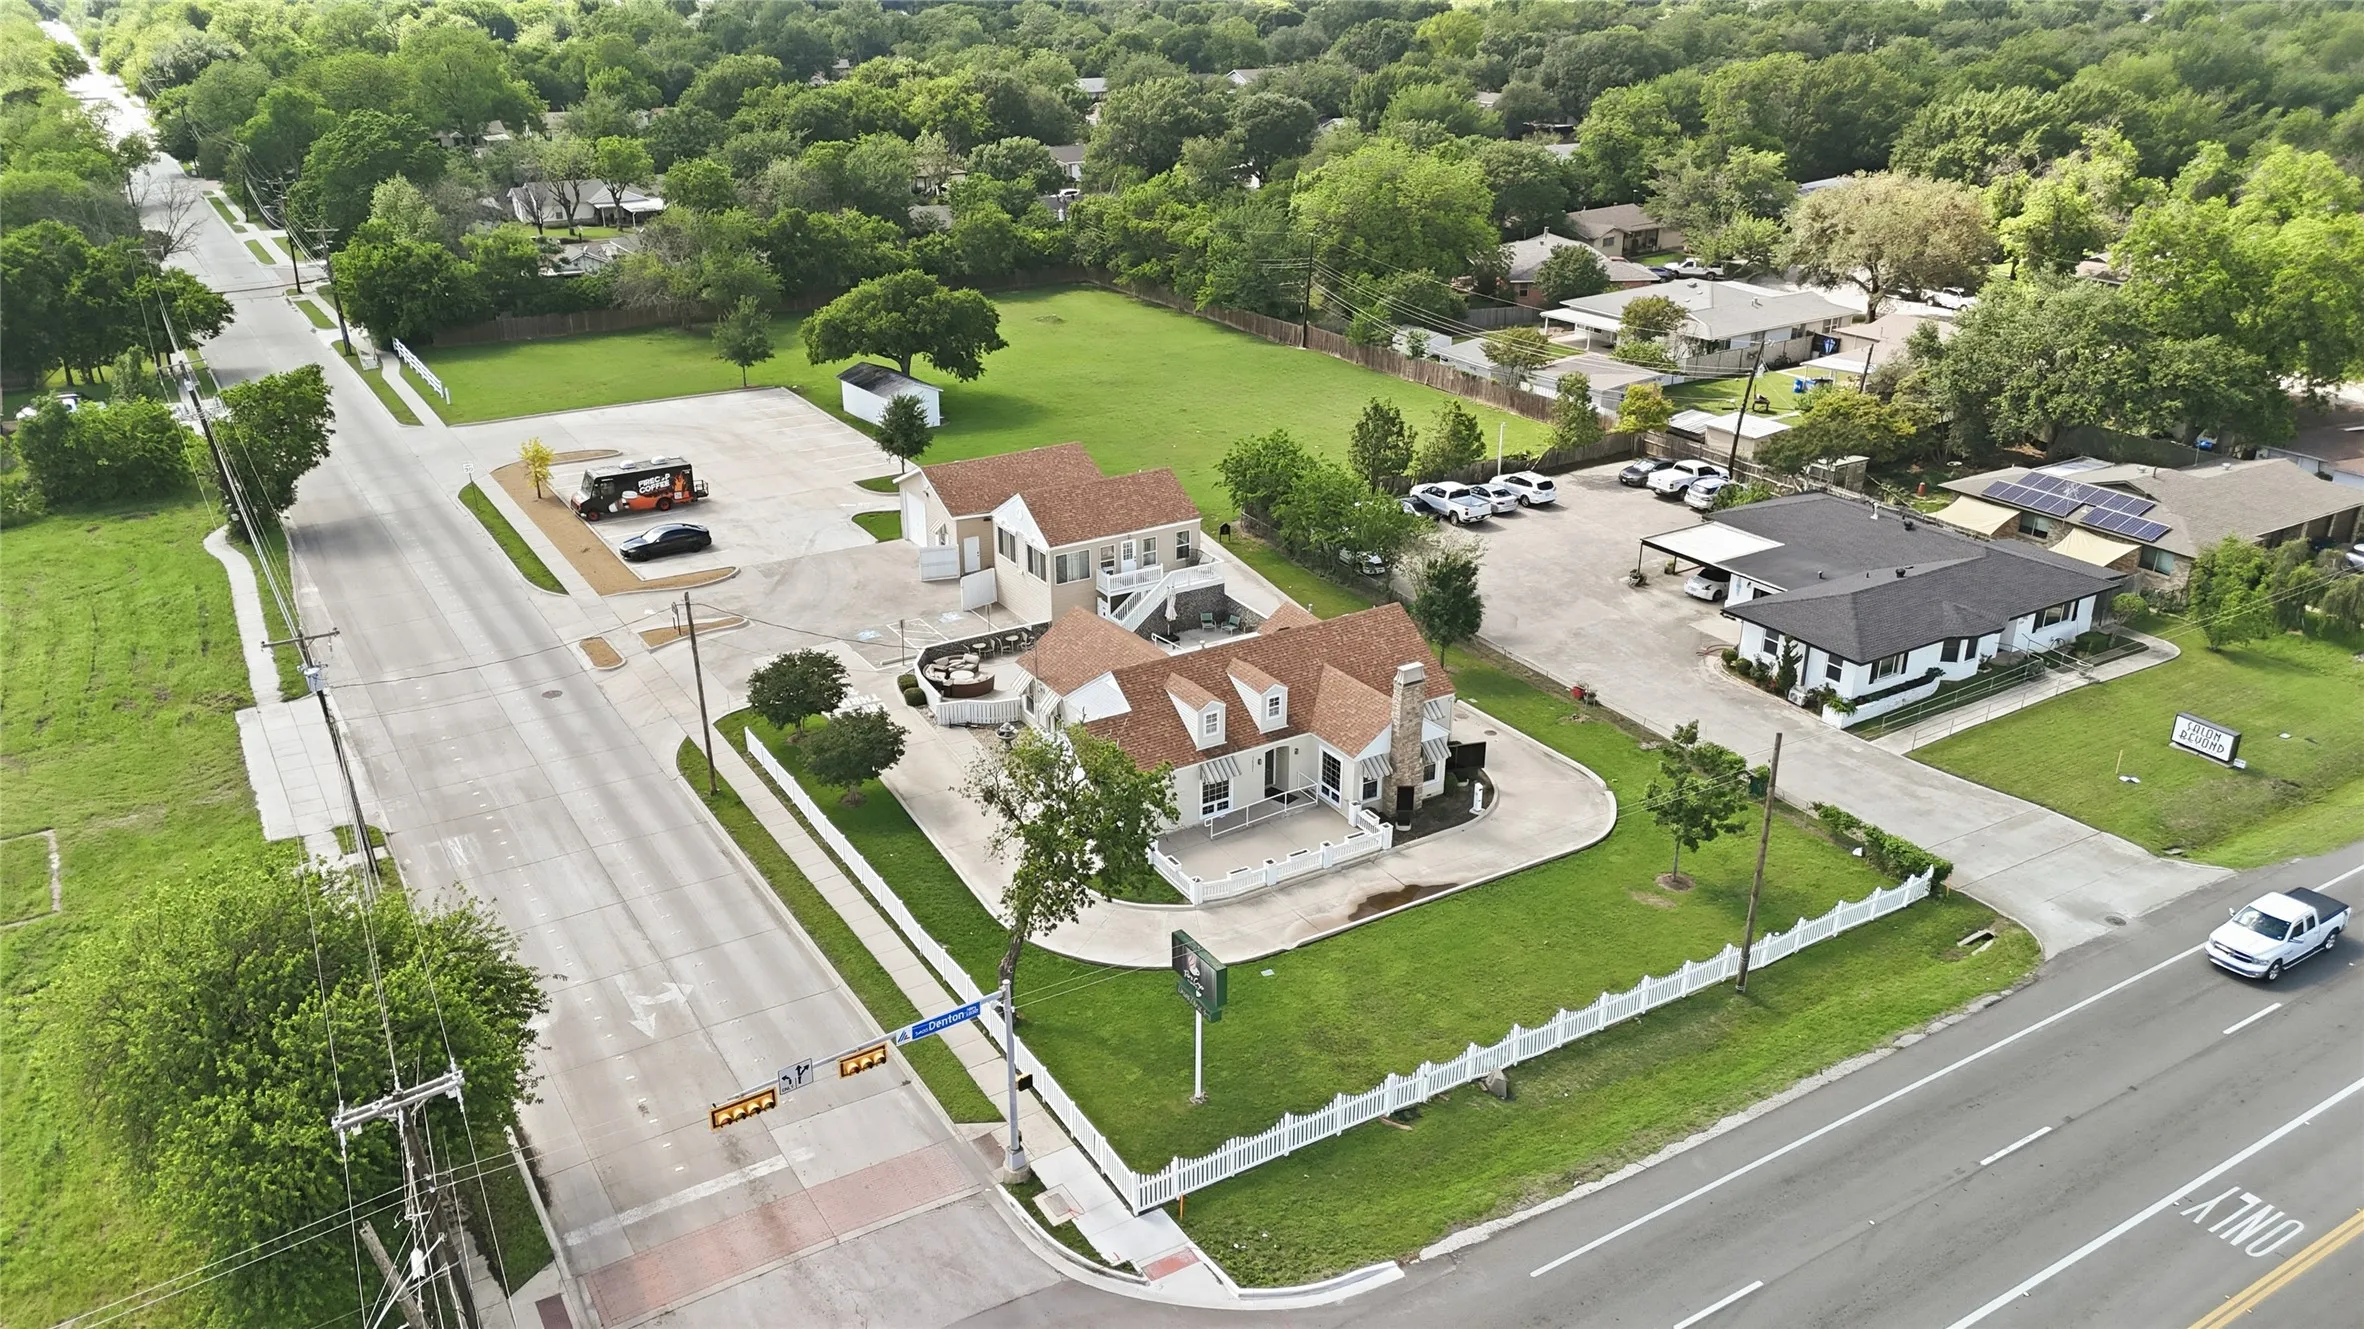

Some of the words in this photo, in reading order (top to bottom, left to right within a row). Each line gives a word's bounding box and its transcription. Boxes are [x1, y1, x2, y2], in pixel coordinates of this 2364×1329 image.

[638, 473, 671, 488] FIRECP
[639, 480, 671, 494] COFFEE
[2187, 721, 2222, 743] SALON
[928, 1011, 965, 1030] Denton
[2179, 1186, 2305, 1258] ONLY
